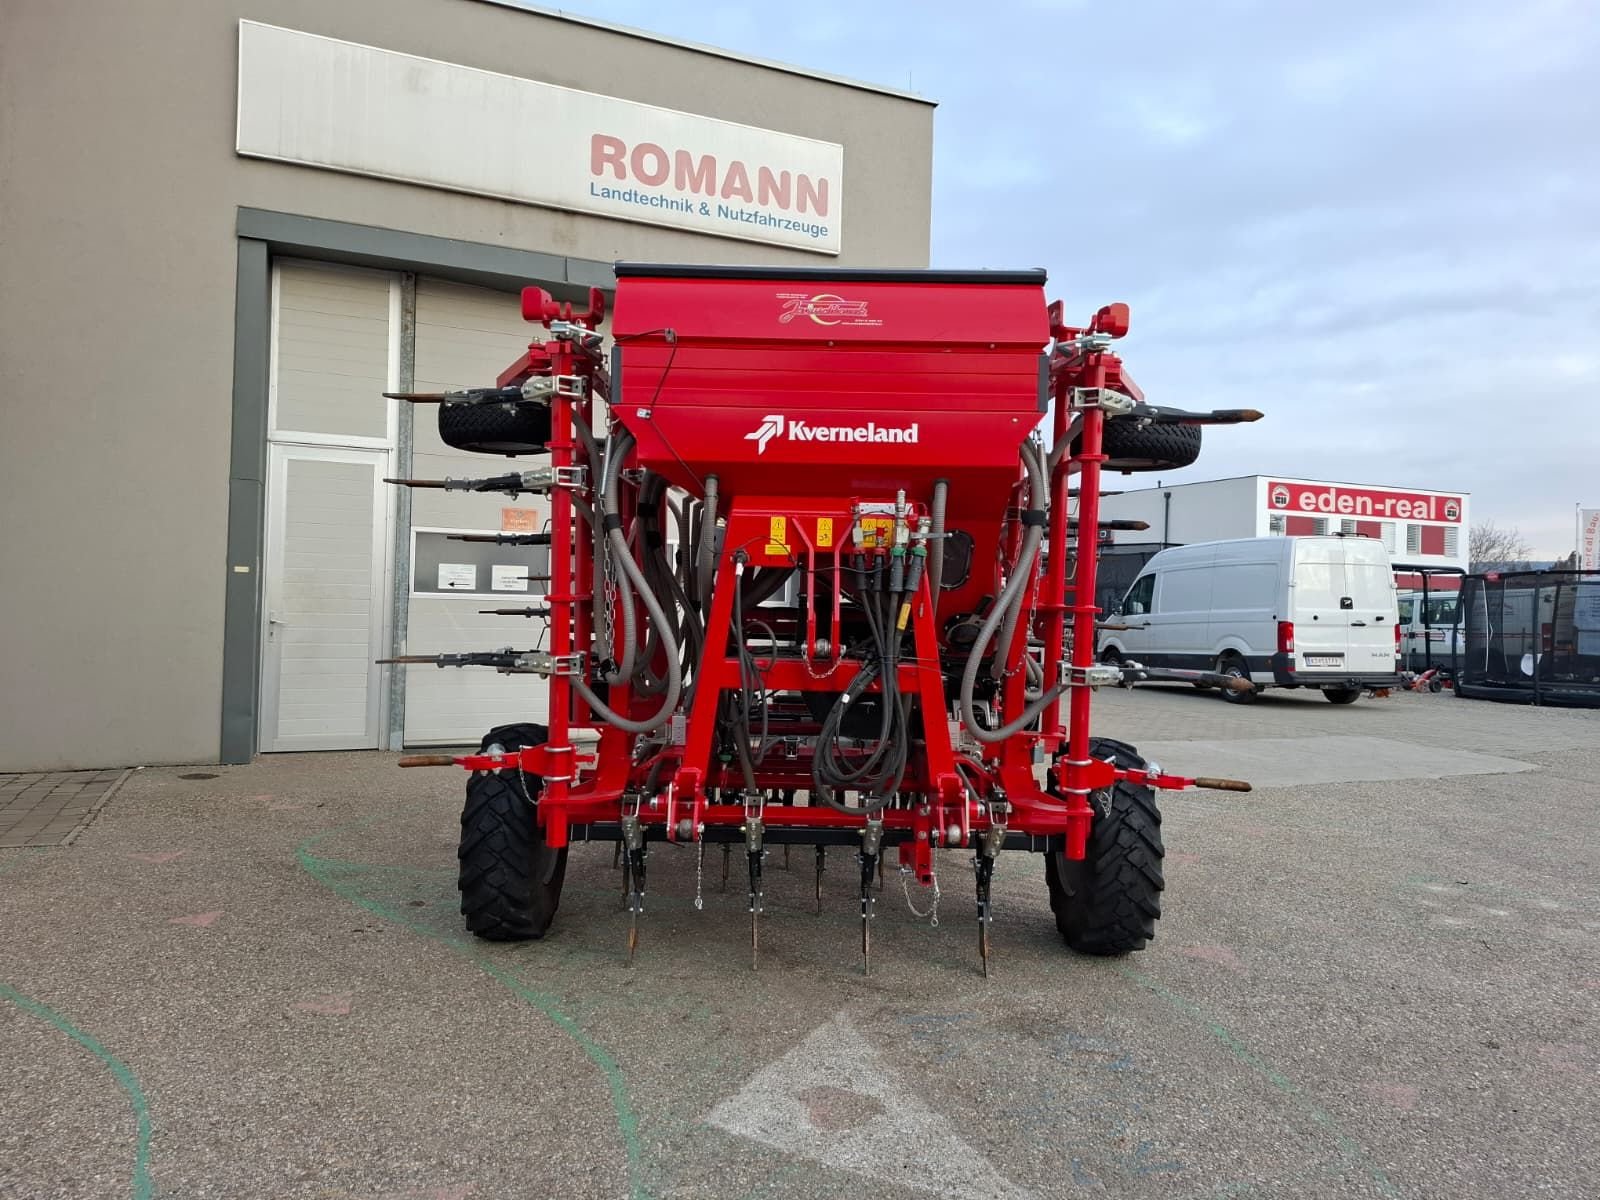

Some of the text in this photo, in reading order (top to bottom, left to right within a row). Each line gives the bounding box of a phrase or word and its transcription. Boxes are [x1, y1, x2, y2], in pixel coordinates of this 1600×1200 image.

[590, 133, 829, 217] ROMANN
[590, 182, 829, 238] Landtechnik & Nutzfahrzeuge
[788, 420, 919, 443] Kverneland
[1299, 488, 1436, 519] eden-real
